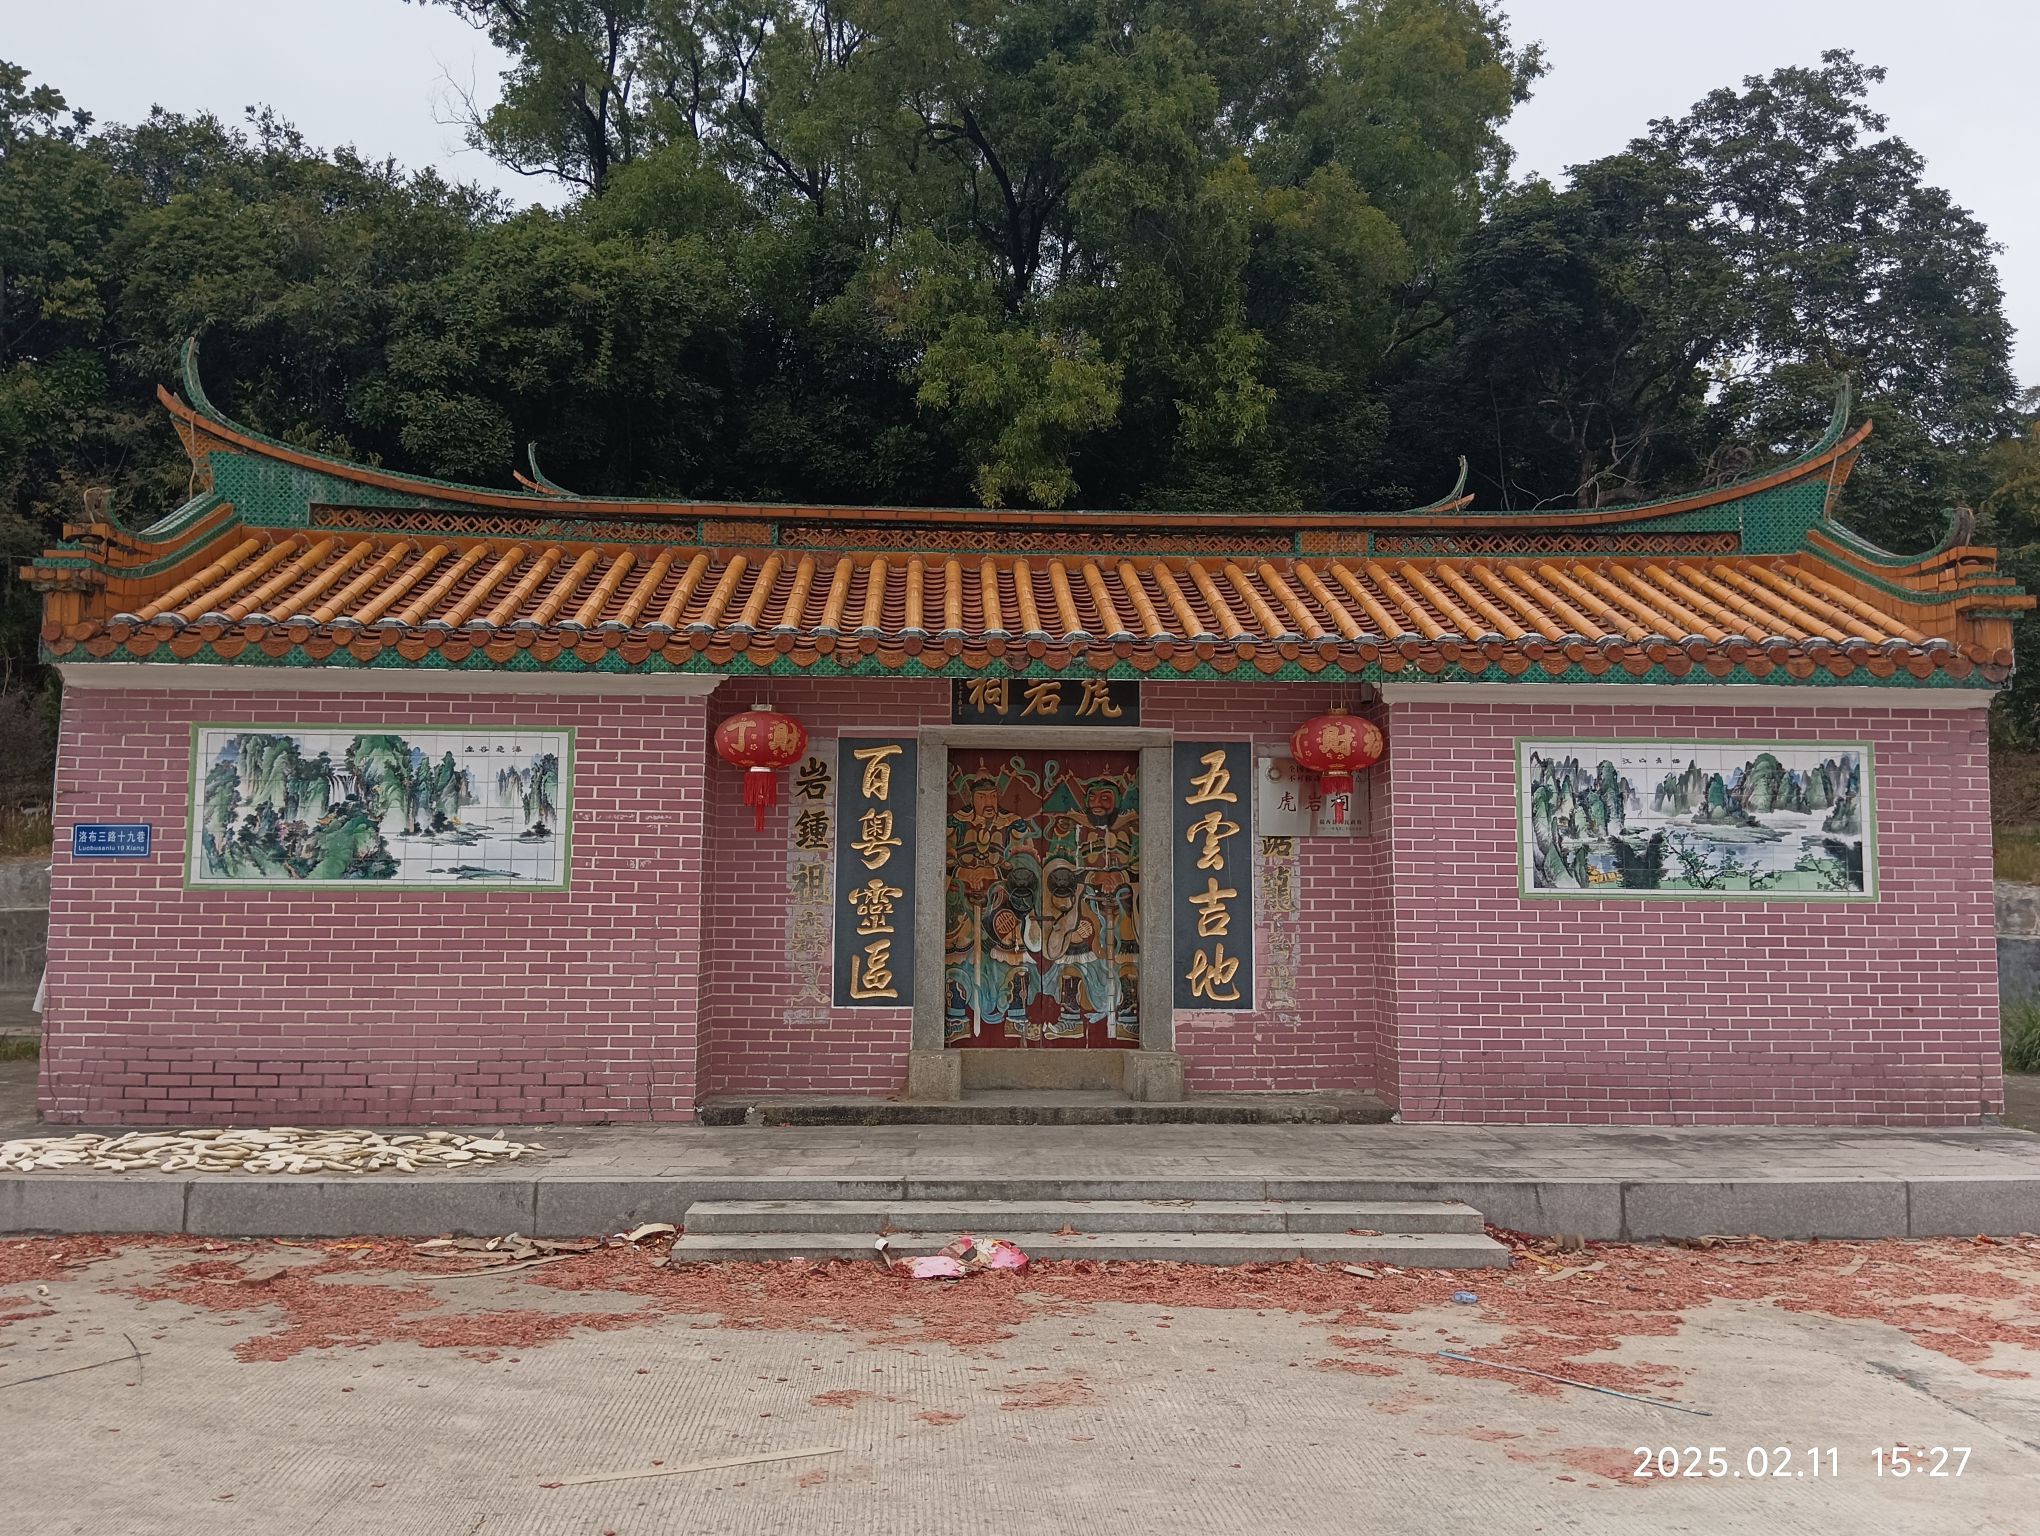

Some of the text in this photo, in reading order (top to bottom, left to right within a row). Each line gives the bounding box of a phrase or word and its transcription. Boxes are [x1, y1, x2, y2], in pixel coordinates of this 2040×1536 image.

[78, 830, 146, 843] 洛布三路十九巷
